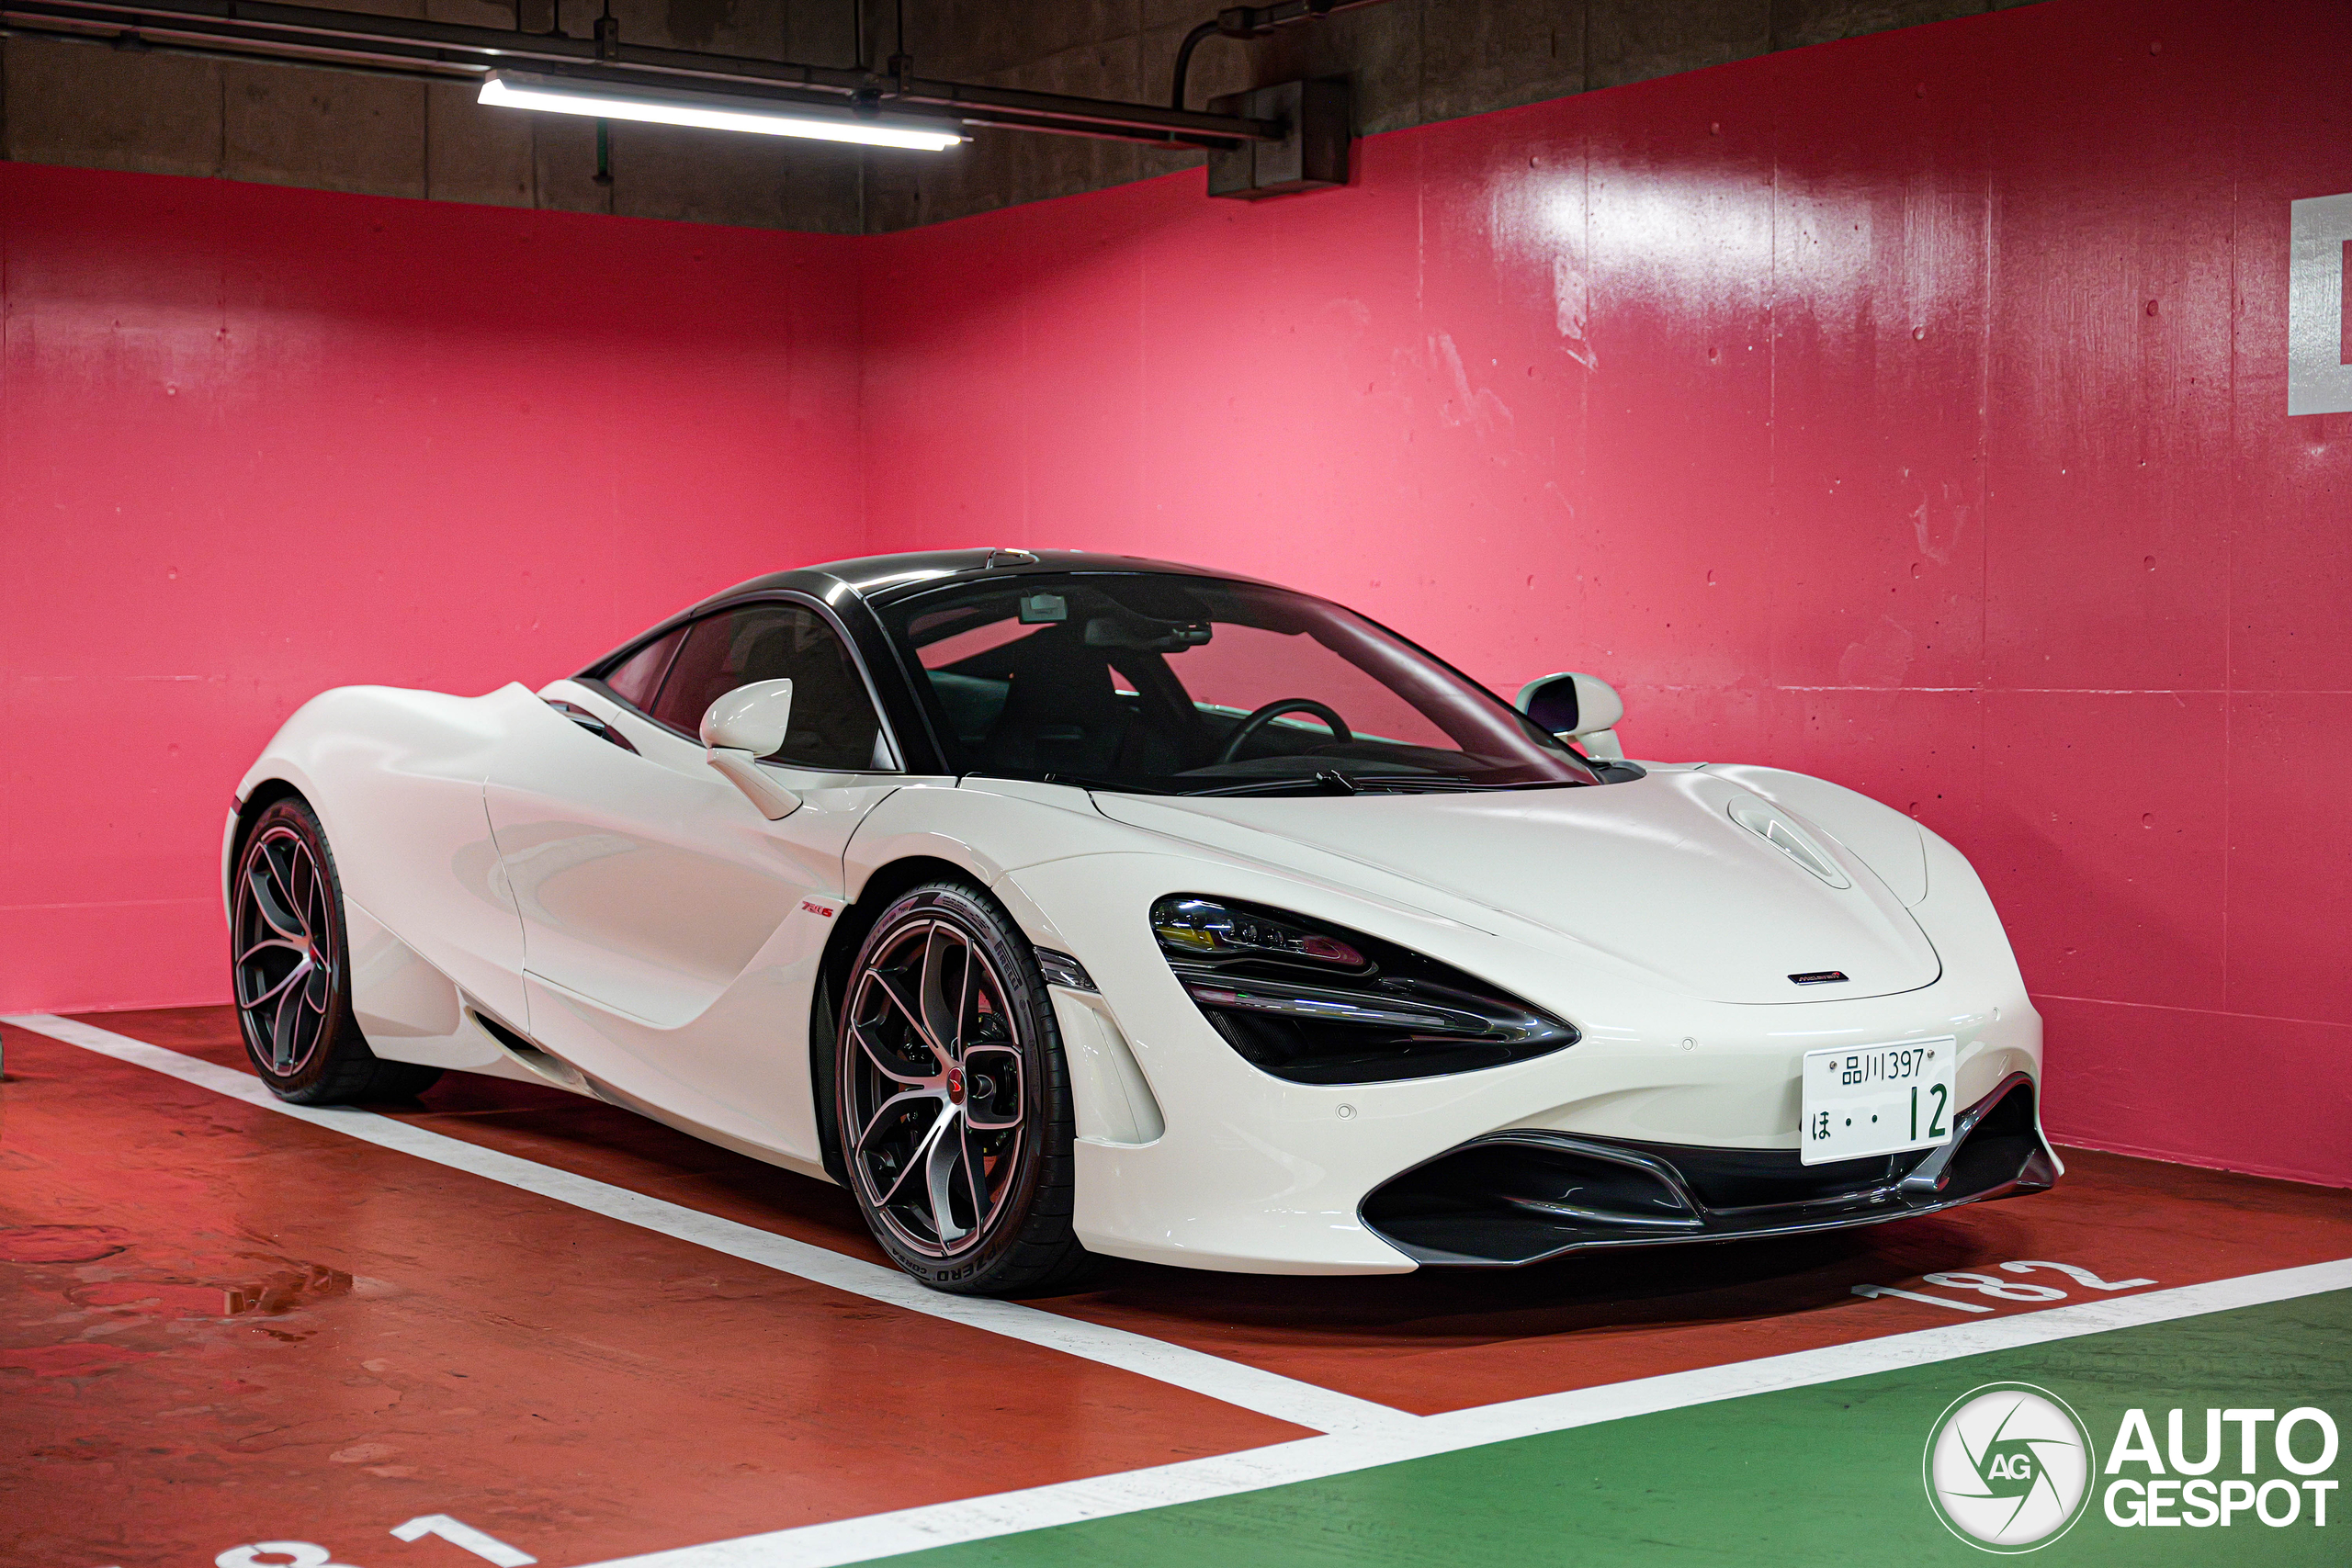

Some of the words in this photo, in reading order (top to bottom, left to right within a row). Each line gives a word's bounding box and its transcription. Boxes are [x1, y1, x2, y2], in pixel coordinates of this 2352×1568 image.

[802, 901, 833, 918] 720S
[994, 940, 1023, 992] PIRELLI
[891, 1247, 927, 1274] CORSA
[1850, 1260, 2159, 1314] 182
